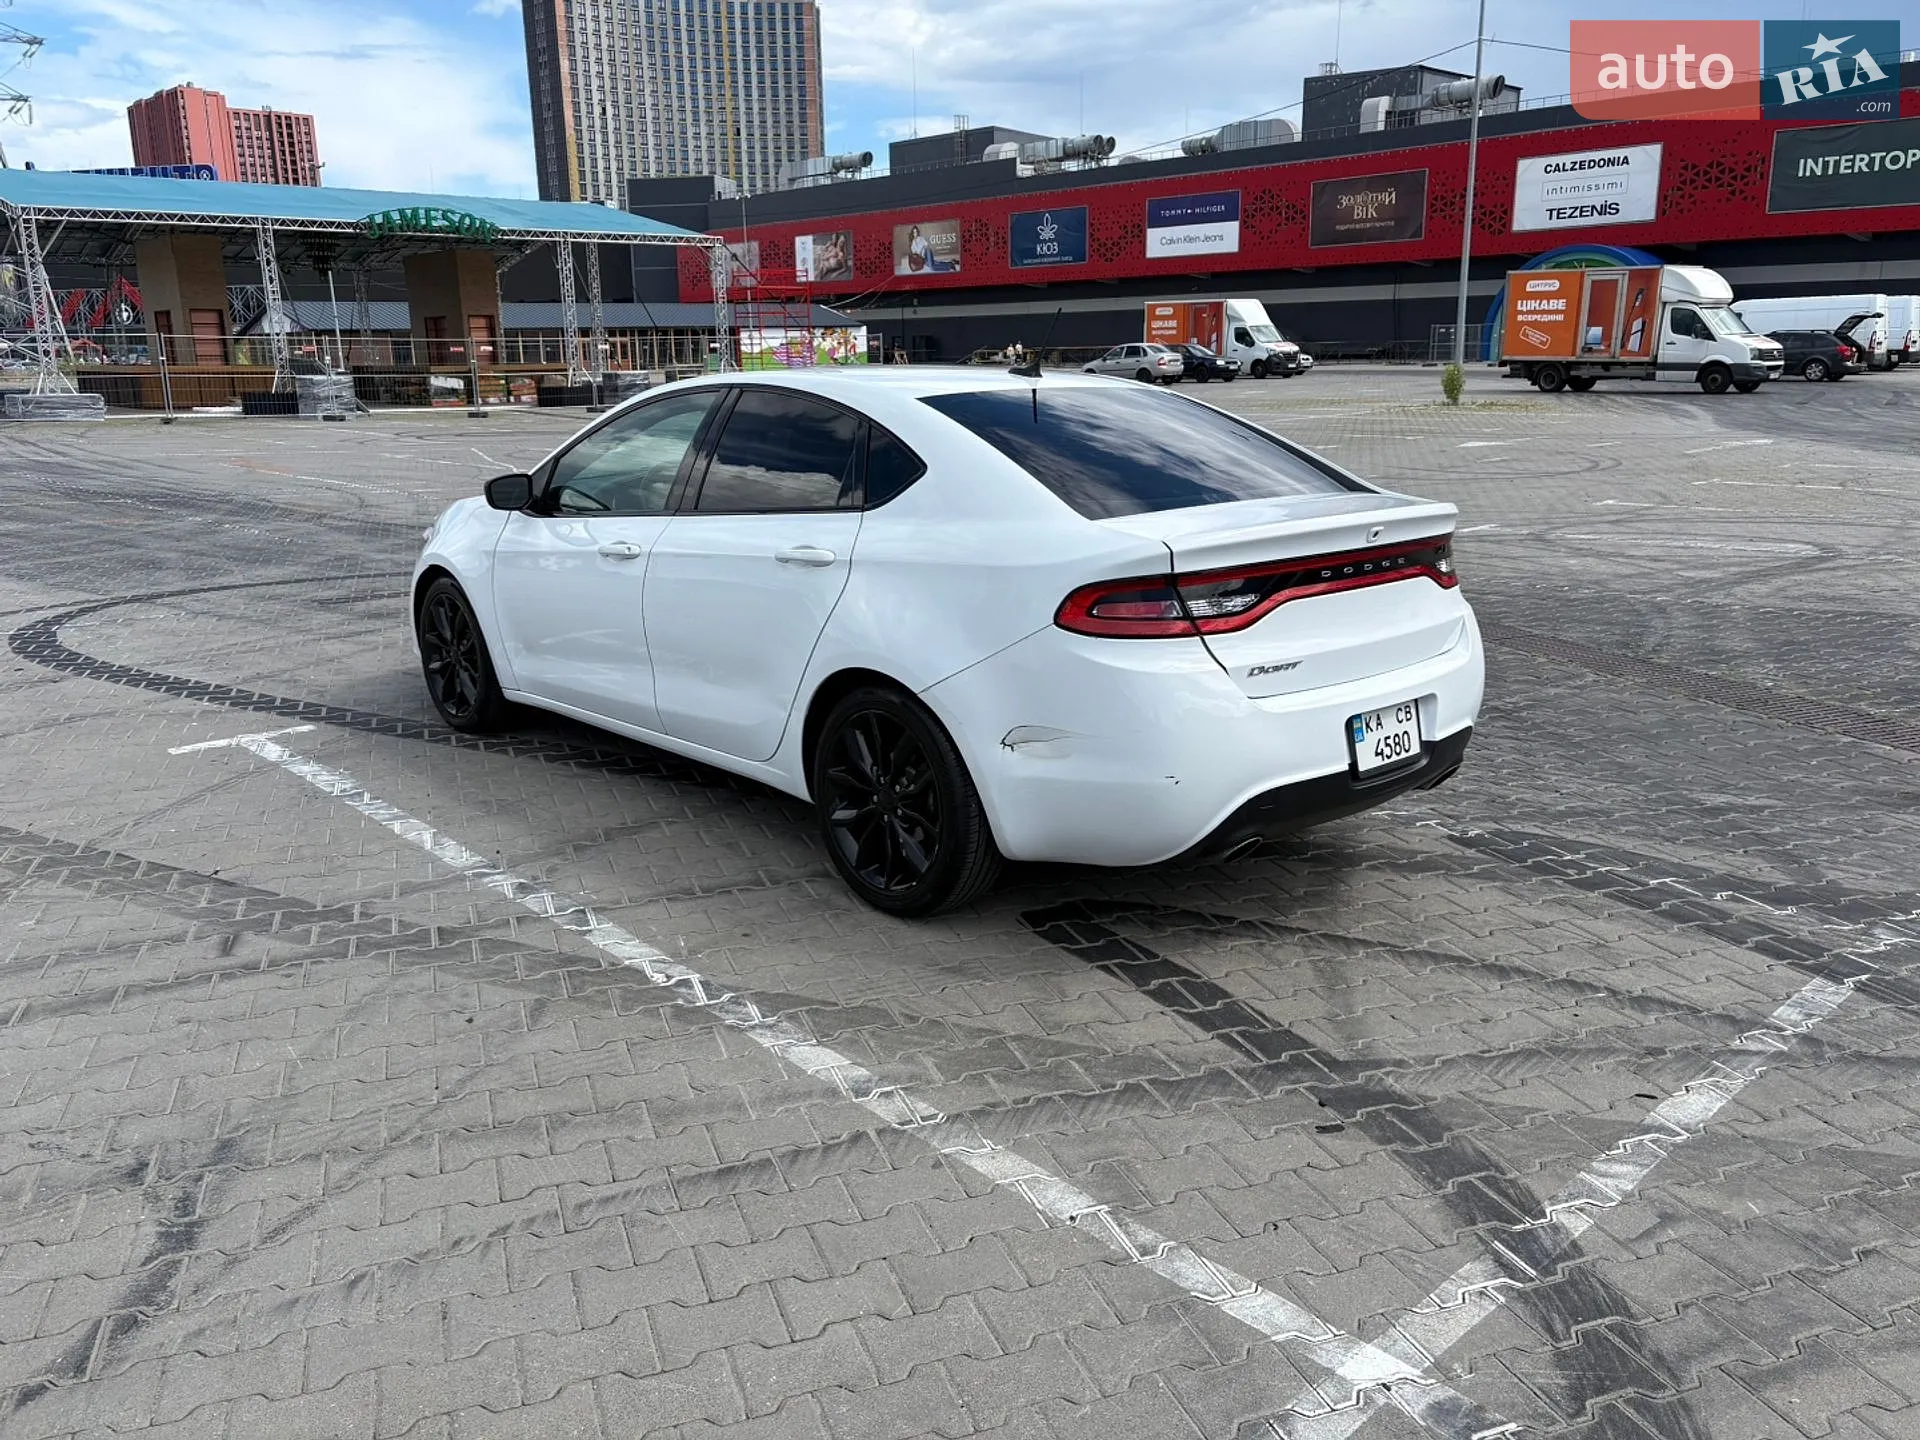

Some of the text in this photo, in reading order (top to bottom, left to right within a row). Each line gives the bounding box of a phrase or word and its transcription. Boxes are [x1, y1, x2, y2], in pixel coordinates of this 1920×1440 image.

[1544, 155, 1630, 175] CALZEDONIA
[1798, 149, 1920, 177] INTERTOP
[1546, 181, 1623, 196] intimissimi
[1160, 204, 1225, 218] TOMMY HILFIGER
[1545, 200, 1620, 221] TEZENIS
[367, 206, 498, 243] JAMESON
[929, 233, 956, 245] GUESS
[1160, 232, 1224, 247] Calvin Klein Jeans
[1321, 557, 1405, 578] DODGE
[1374, 730, 1412, 762] 4580
